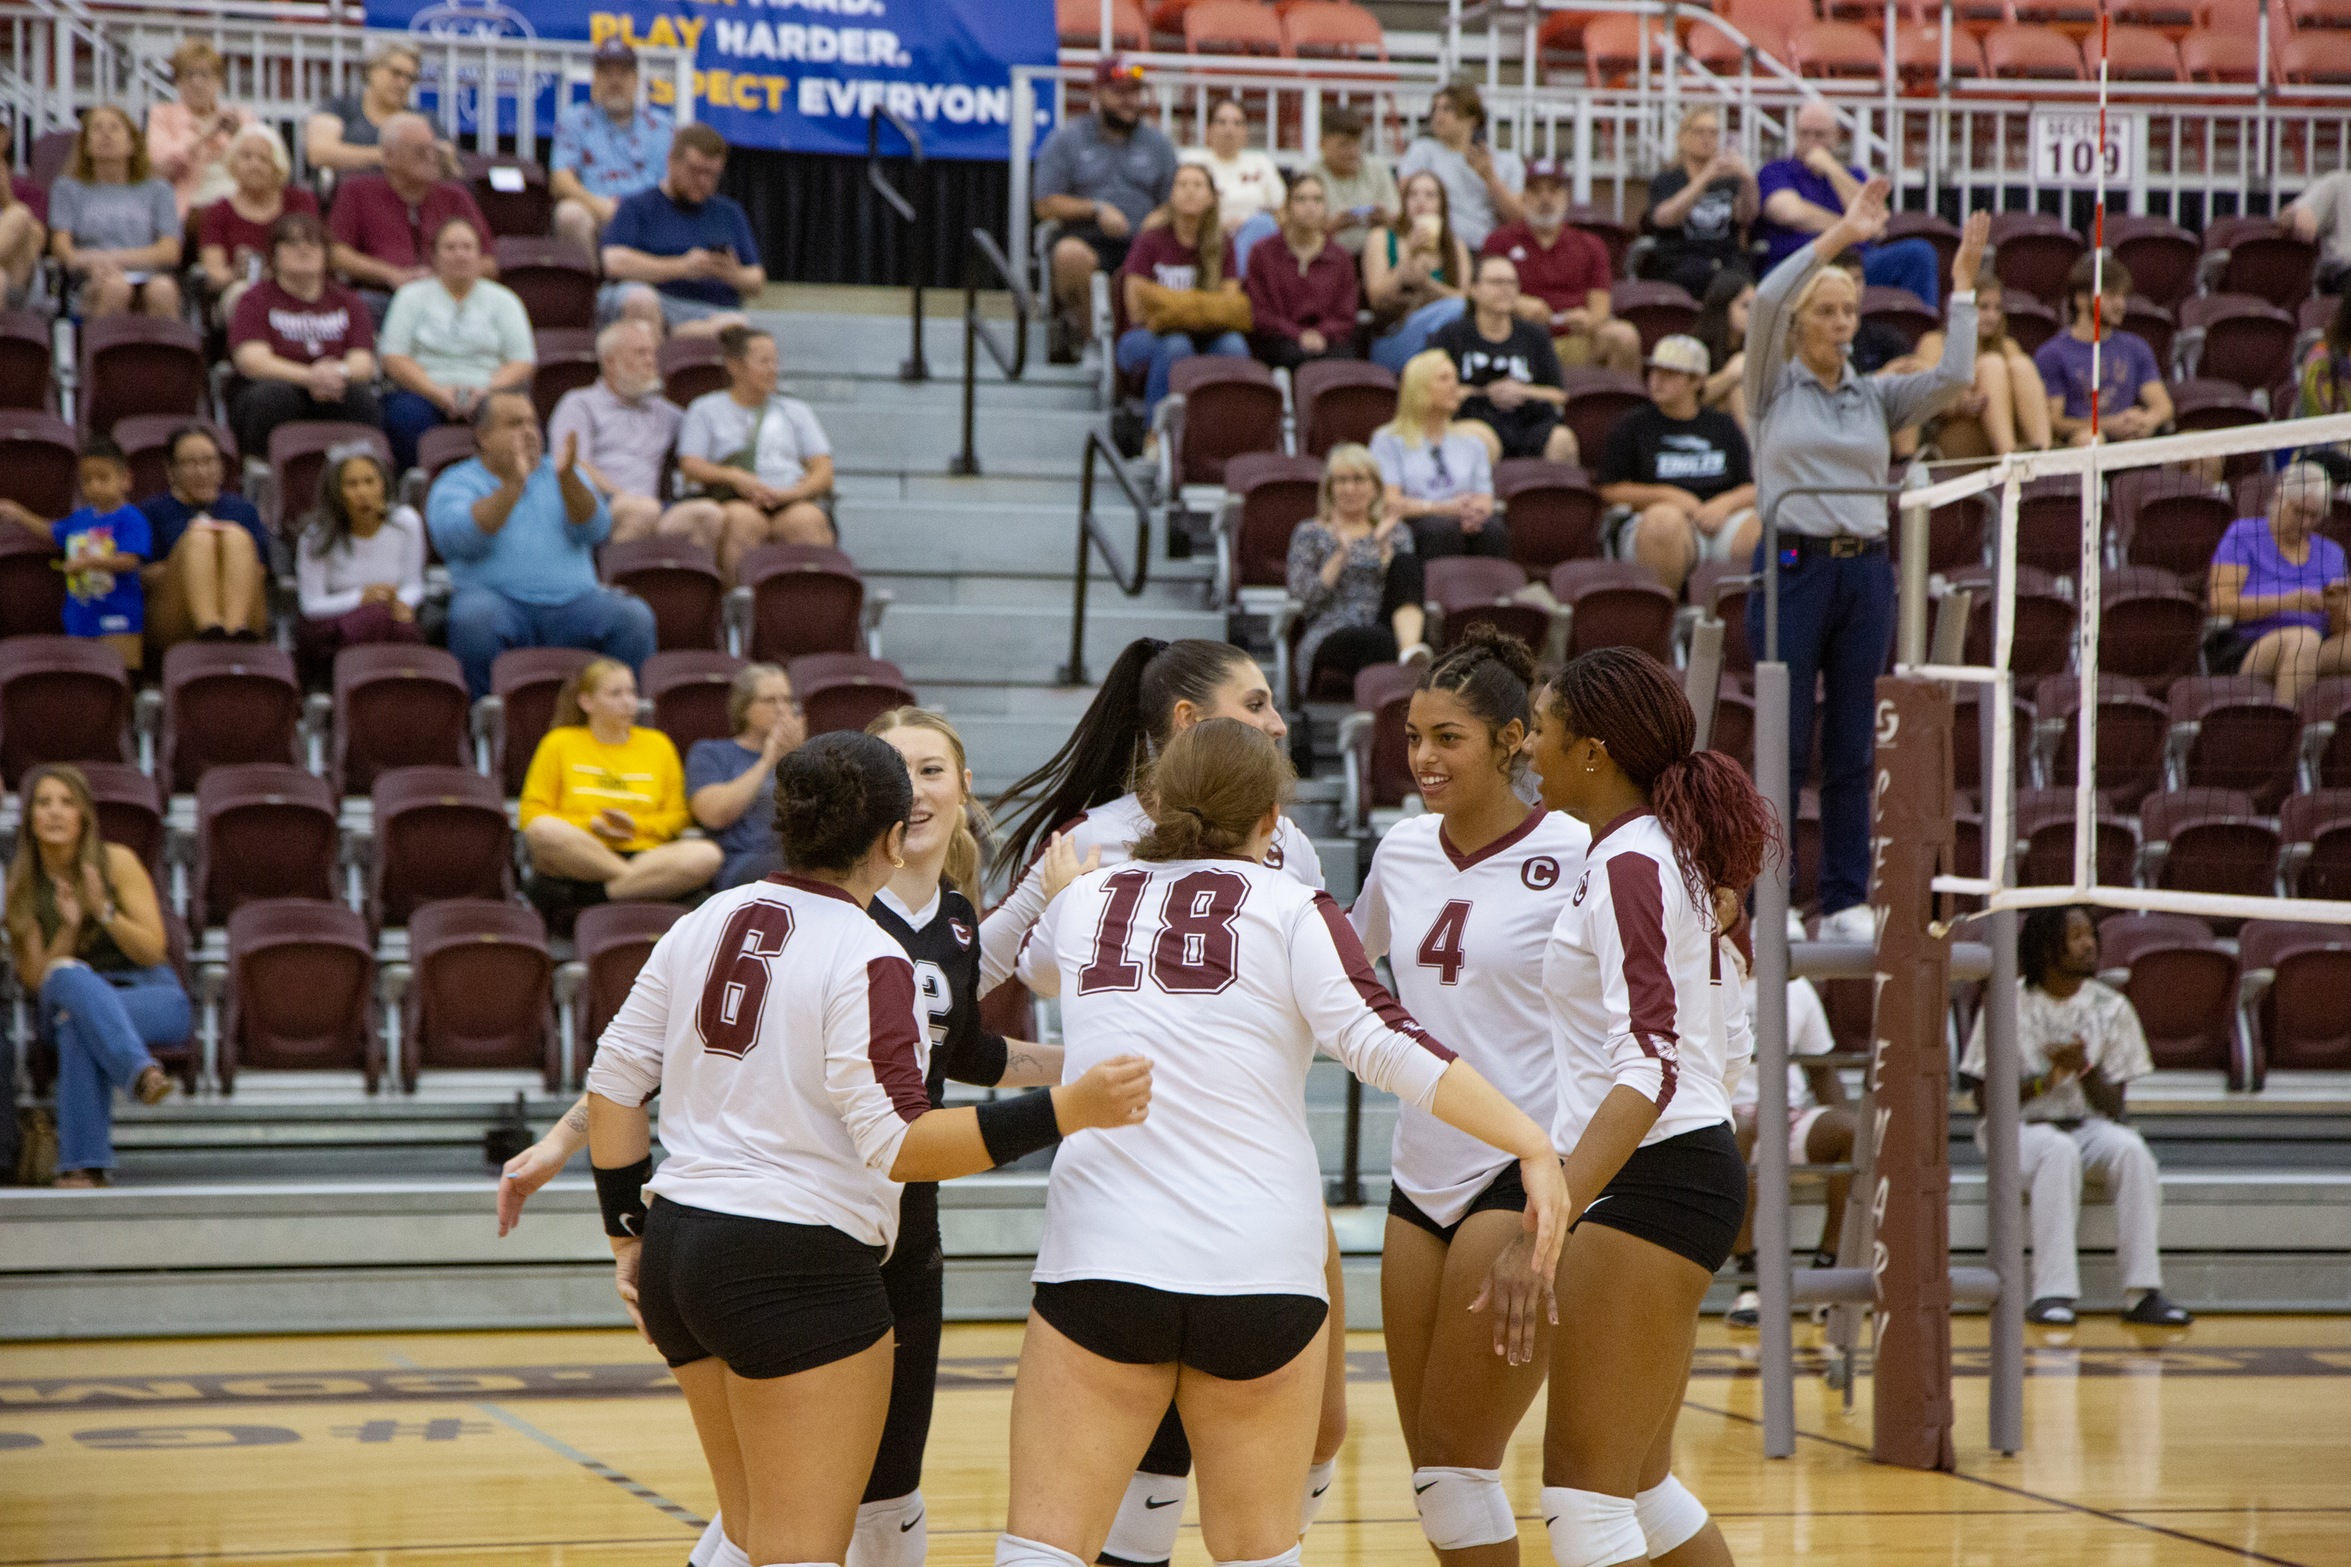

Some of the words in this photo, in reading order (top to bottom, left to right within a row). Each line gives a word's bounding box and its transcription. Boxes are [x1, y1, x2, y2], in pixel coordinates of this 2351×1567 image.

[589, 13, 705, 50] PLAY
[715, 18, 912, 67] HARDER.
[798, 76, 1049, 126] EVERYON.
[2049, 141, 2120, 175] 109
[1526, 859, 1555, 887] C
[1077, 867, 1251, 995] 18
[1416, 898, 1474, 986] 4
[695, 898, 795, 1060] 6
